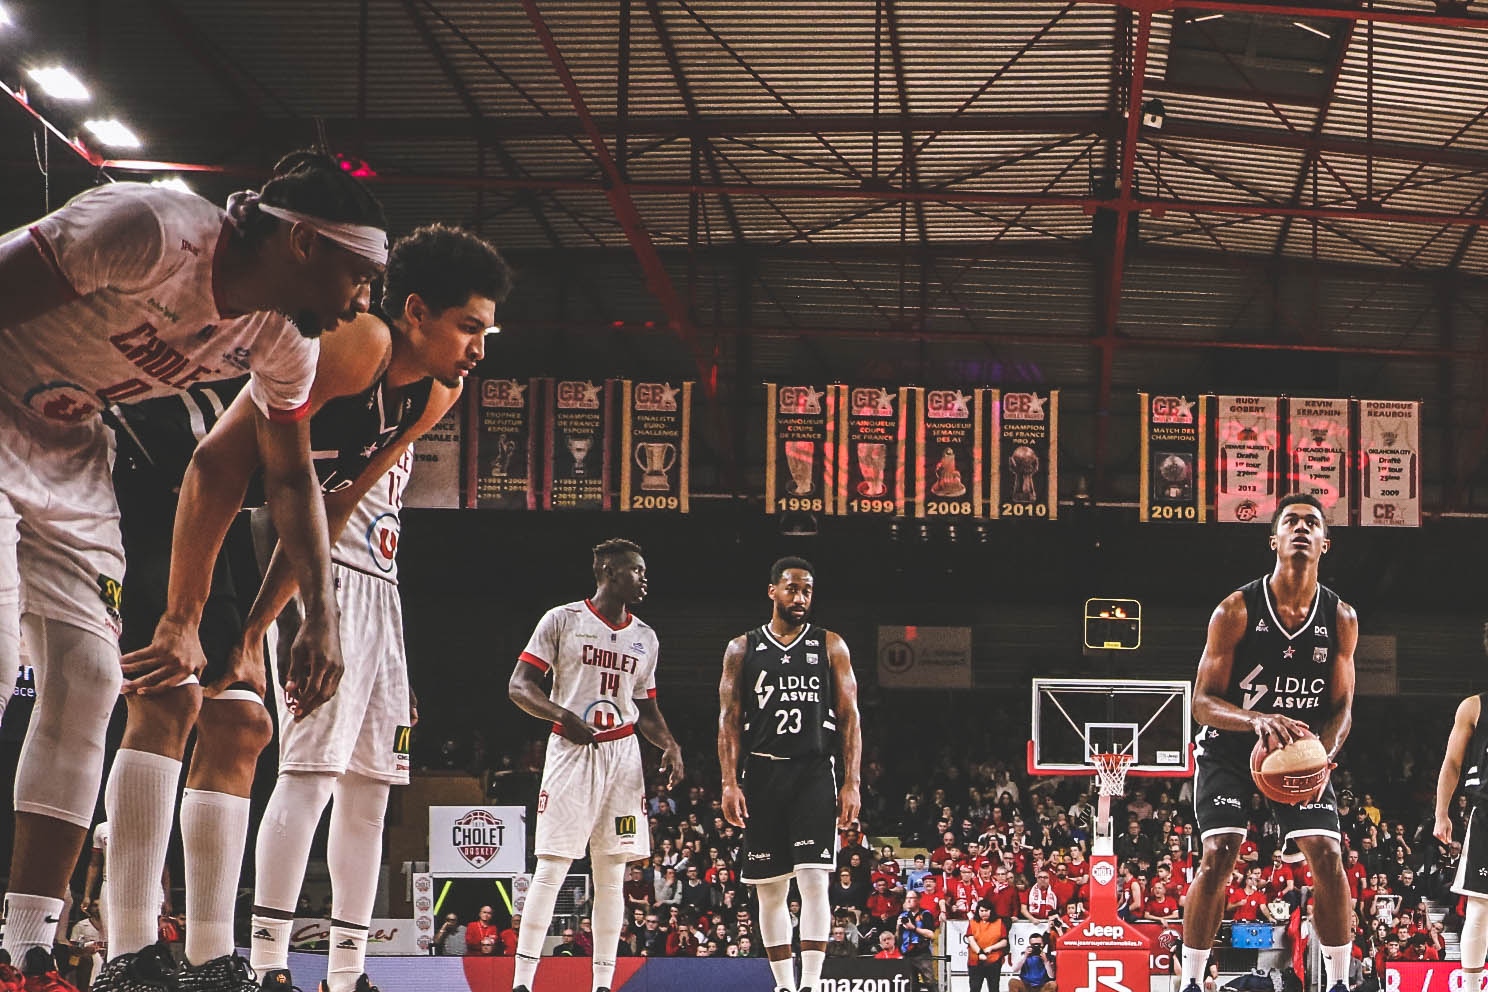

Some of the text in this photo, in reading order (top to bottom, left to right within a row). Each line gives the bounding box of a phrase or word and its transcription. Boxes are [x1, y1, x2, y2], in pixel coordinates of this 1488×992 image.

[632, 495, 678, 509] 2009
[778, 498, 822, 511] 1998
[850, 499, 894, 513] 1999
[927, 501, 971, 515] 2008
[1002, 504, 1046, 517] 2010
[1152, 506, 1195, 519] 2010
[582, 644, 639, 675] CHOLET
[600, 671, 620, 698] 14
[779, 676, 820, 690] LDLC
[1274, 676, 1325, 694] LDLC
[780, 691, 820, 703] ASVEL
[1273, 696, 1319, 709] ASVEL
[774, 708, 802, 735] 23
[452, 826, 505, 846] CHOLET
[464, 847, 494, 856] BASKET
[1083, 922, 1124, 940] Jeep
